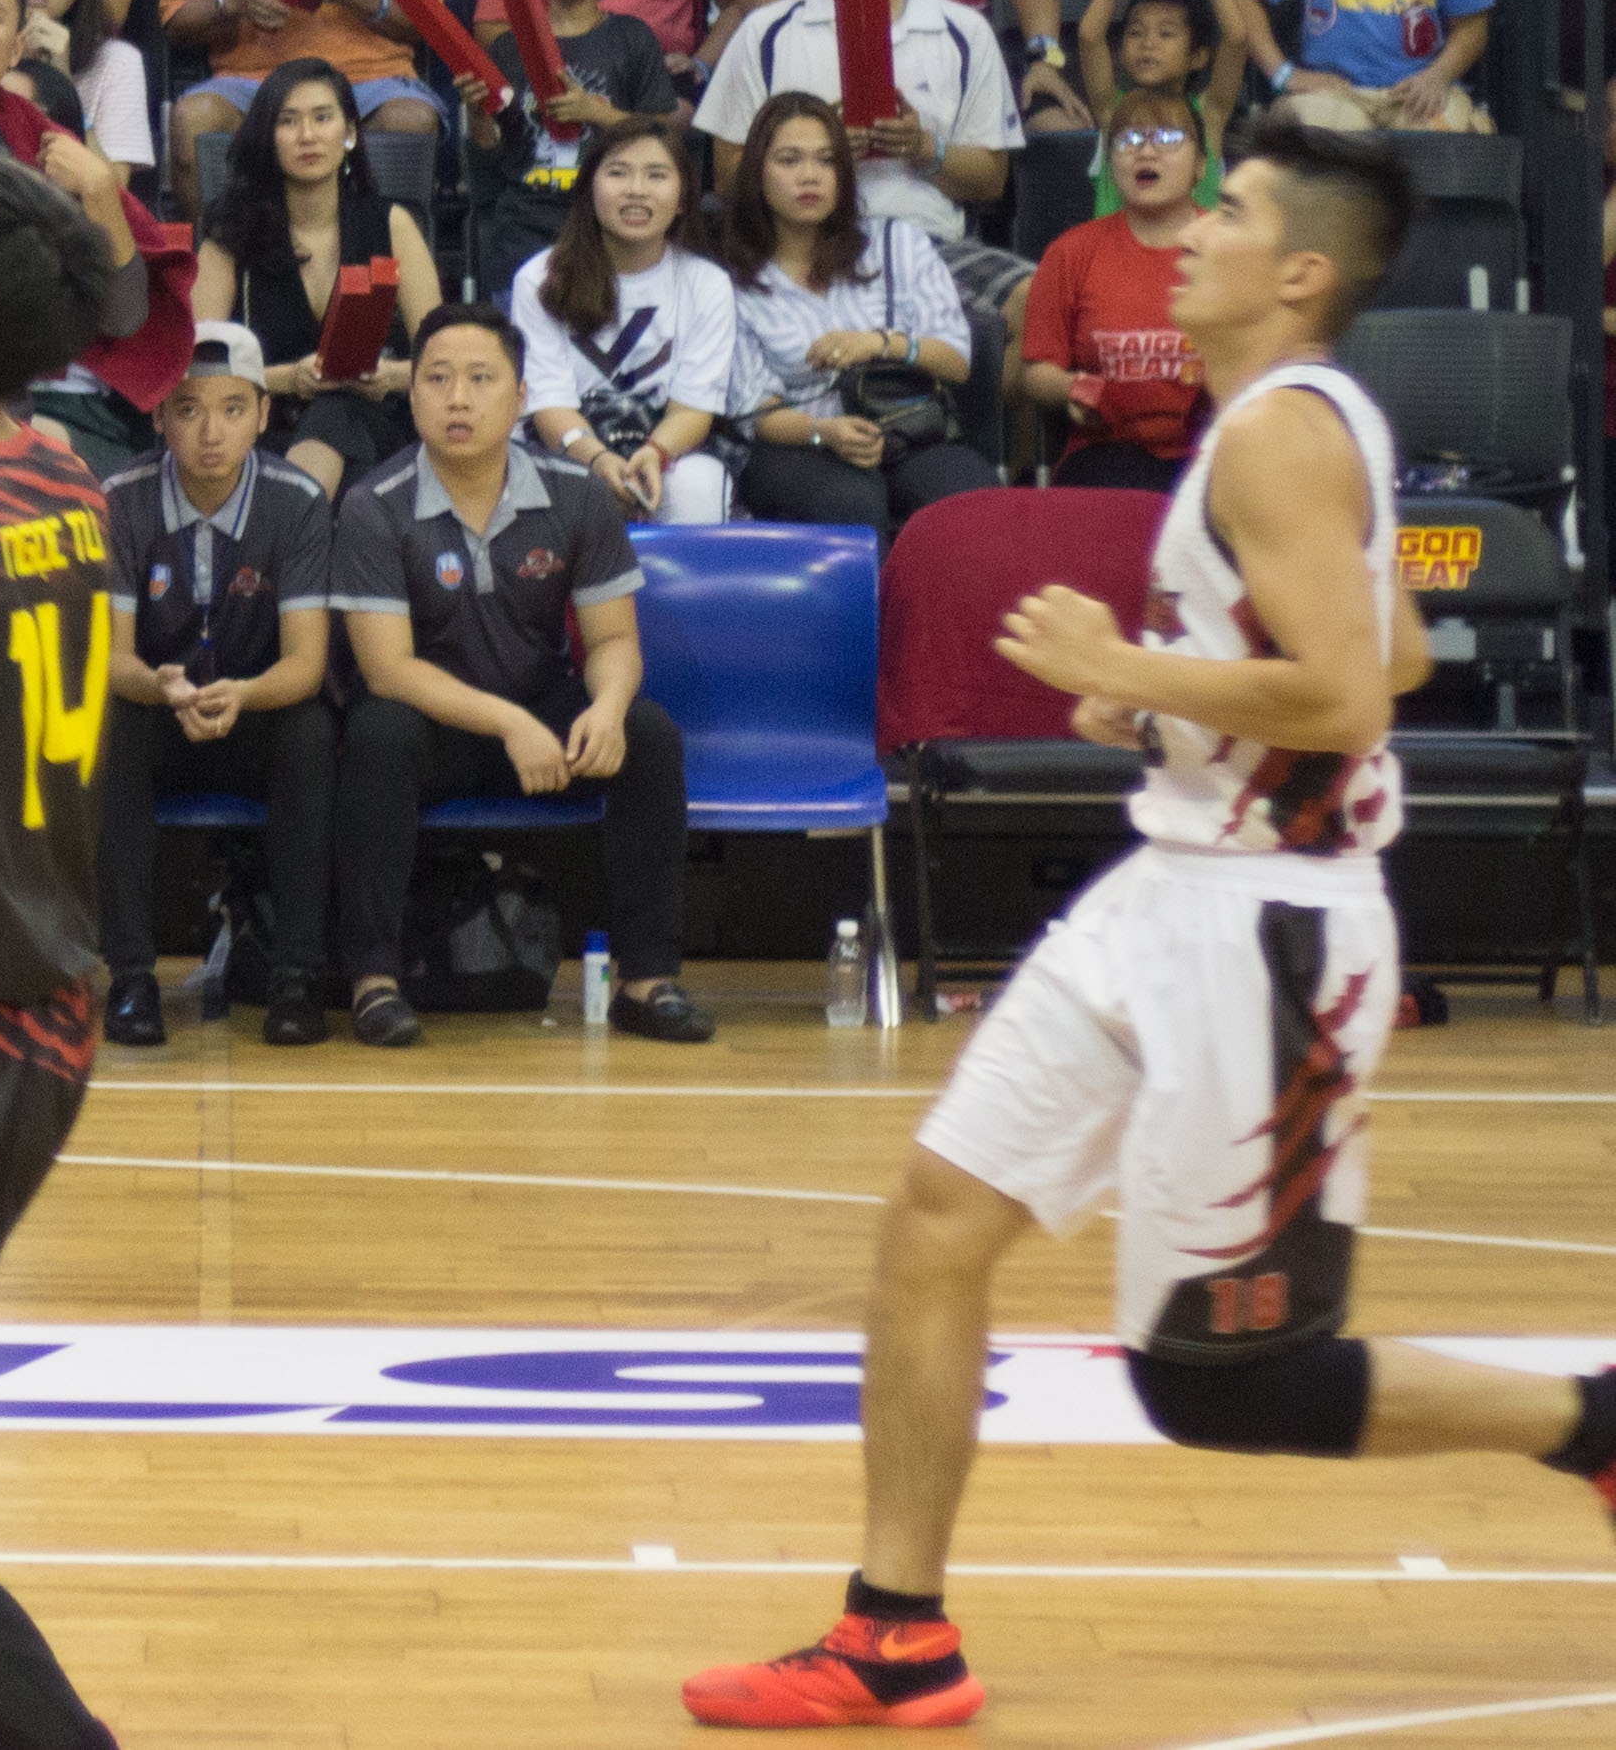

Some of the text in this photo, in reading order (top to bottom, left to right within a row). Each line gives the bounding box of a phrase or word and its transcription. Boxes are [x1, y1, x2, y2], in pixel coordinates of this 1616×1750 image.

[1396, 529, 1481, 562] GON
[1403, 558, 1475, 589] EAT
[8, 591, 113, 831] 14
